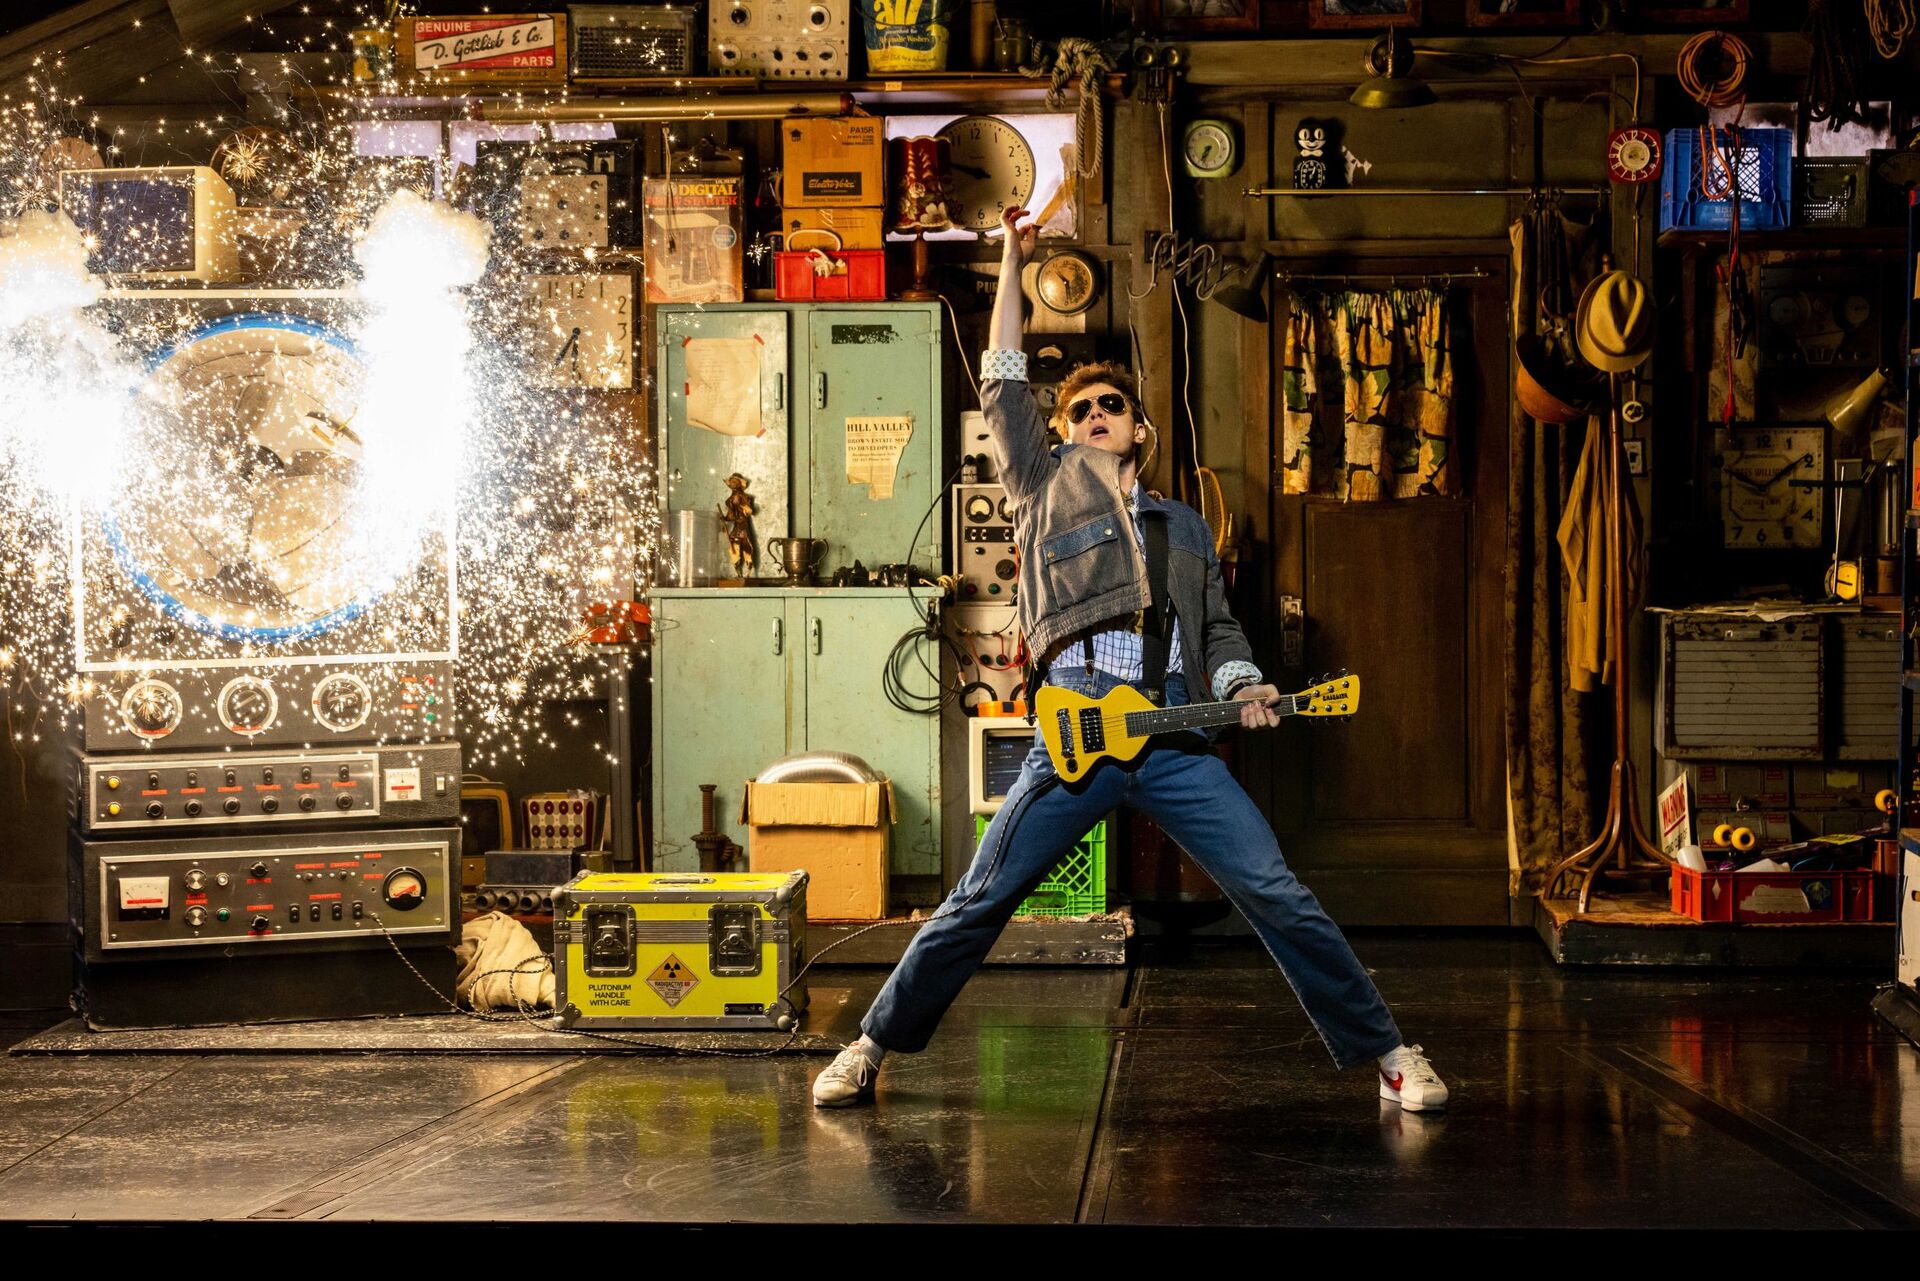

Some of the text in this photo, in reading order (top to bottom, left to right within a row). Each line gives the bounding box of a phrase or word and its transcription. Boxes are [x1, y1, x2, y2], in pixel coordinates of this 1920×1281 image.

[416, 22, 472, 32] GENUINE
[422, 42, 448, 60] D.
[454, 30, 505, 62] Gottlieb
[526, 26, 543, 42] Co.
[513, 56, 554, 66] PARTS
[850, 126, 874, 134] PA15R
[970, 128, 980, 140] 12
[1008, 146, 1014, 158] 2
[1015, 166, 1022, 177] 3
[679, 184, 737, 196] DIGITAL
[1012, 186, 1018, 197] 4
[997, 202, 1004, 213] 5
[978, 209, 985, 220] 6
[618, 296, 626, 314] 2
[618, 322, 627, 340] 3
[847, 423, 911, 432] HILL VALLEY
[1801, 508, 1814, 522] 4
[1730, 526, 1744, 539] 7
[1757, 528, 1766, 542] 6
